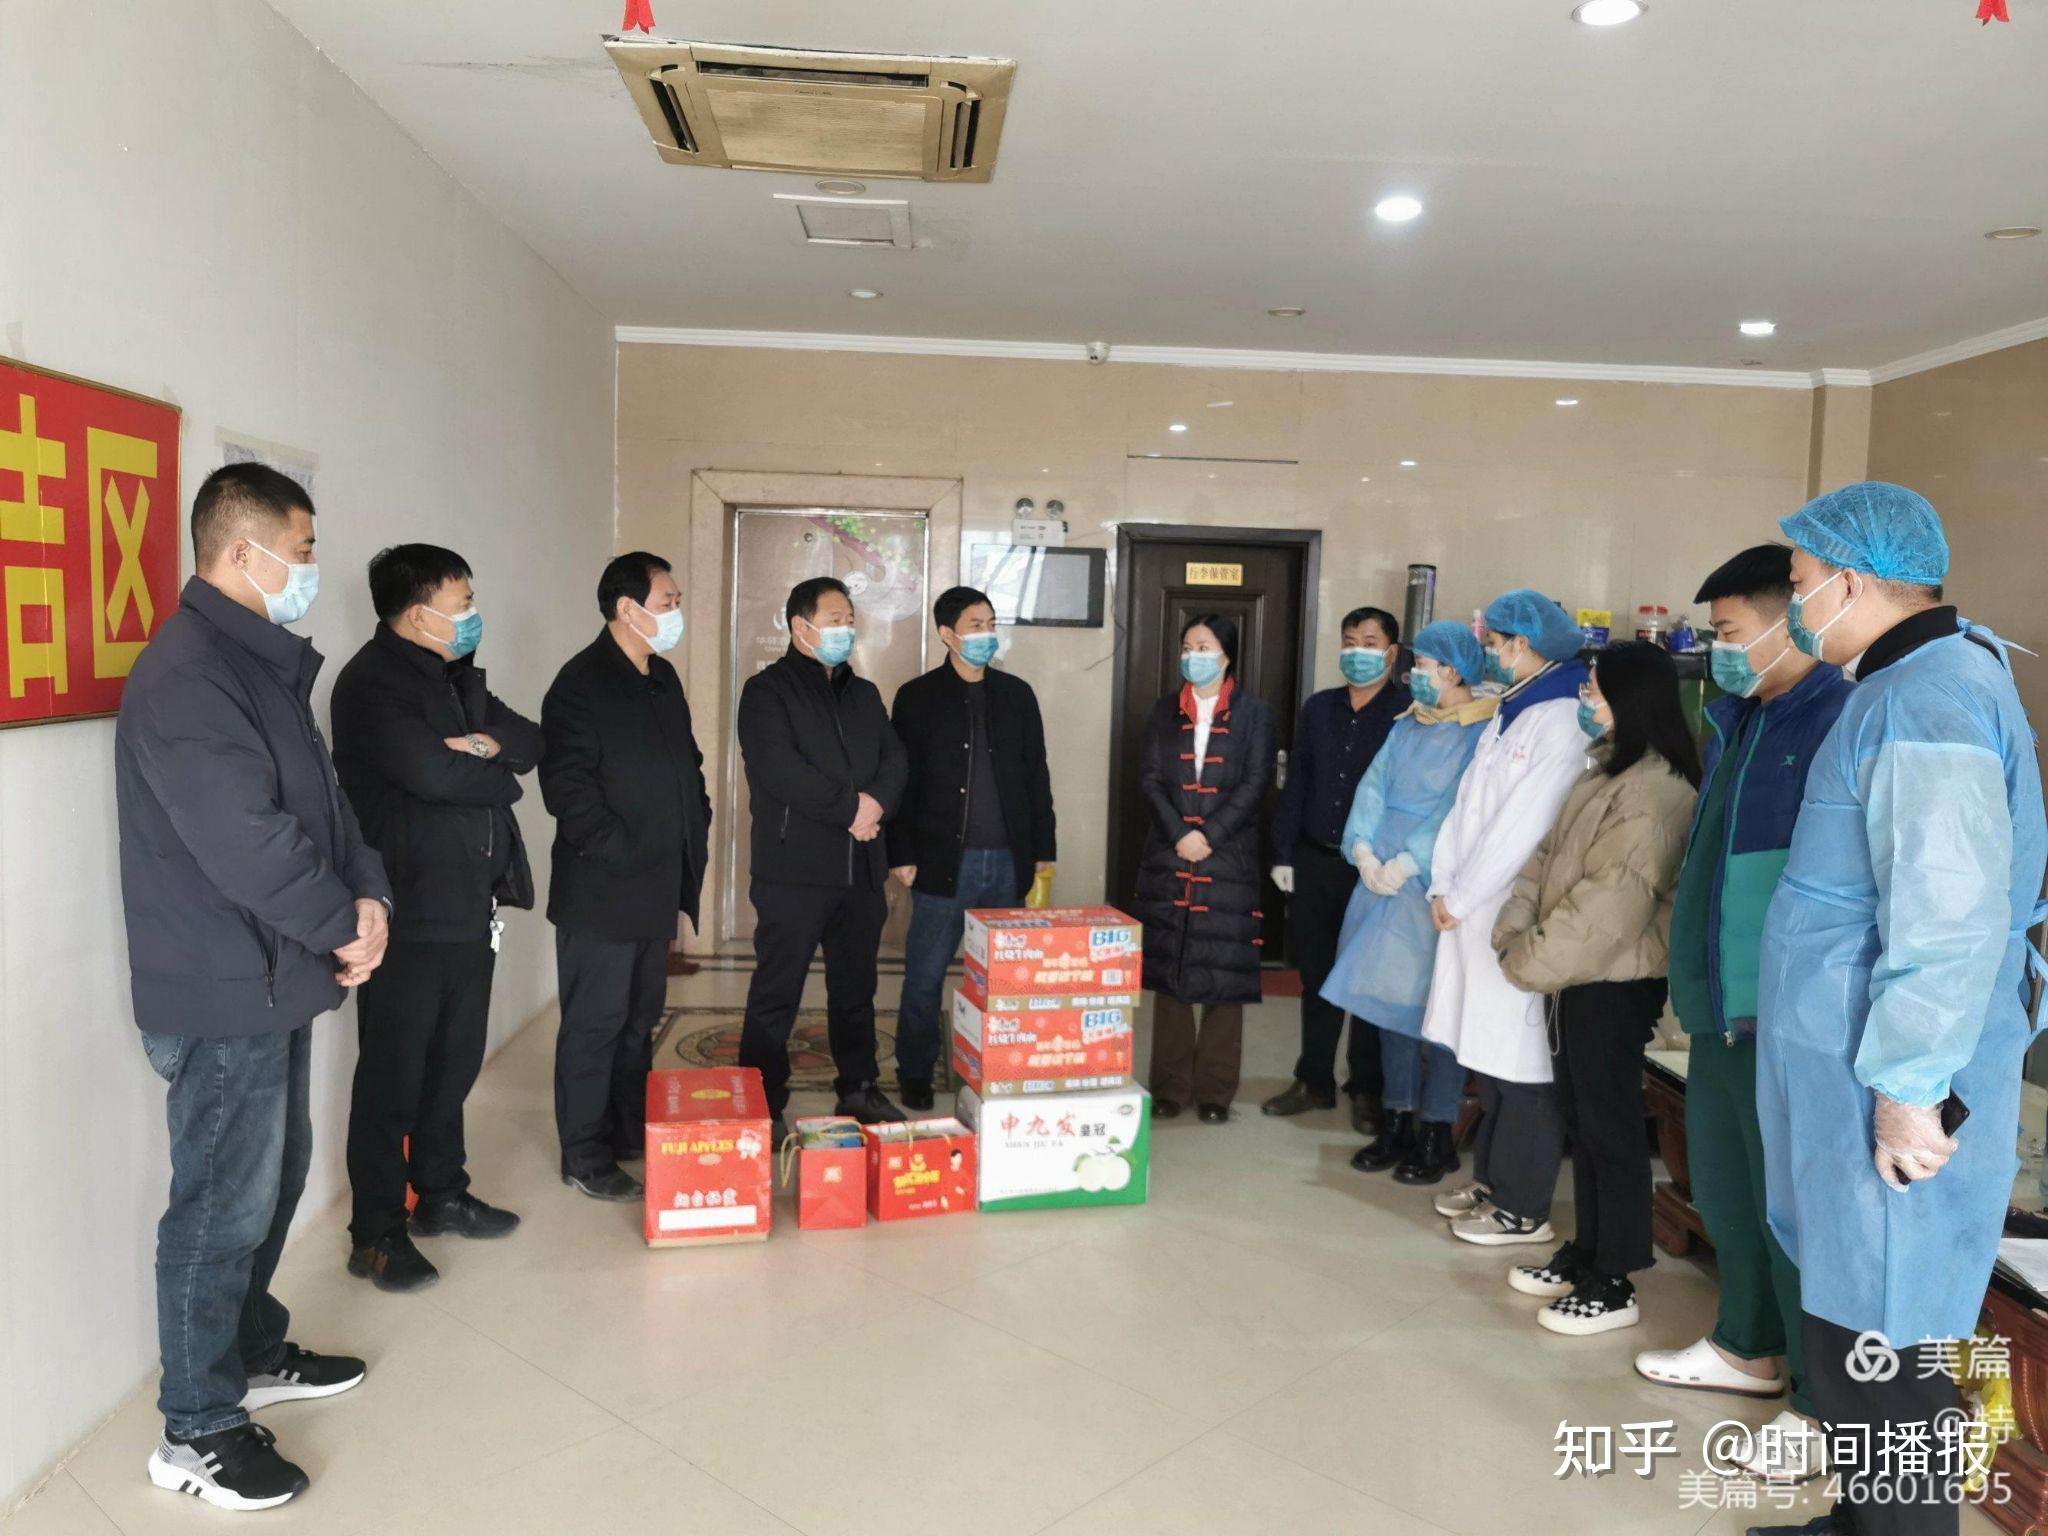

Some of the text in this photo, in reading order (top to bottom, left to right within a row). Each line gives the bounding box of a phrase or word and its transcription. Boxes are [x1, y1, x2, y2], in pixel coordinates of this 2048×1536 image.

[1092, 929, 1129, 946] BIG
[1084, 1012, 1122, 1028] BIG
[661, 1141, 688, 1155] FUJI
